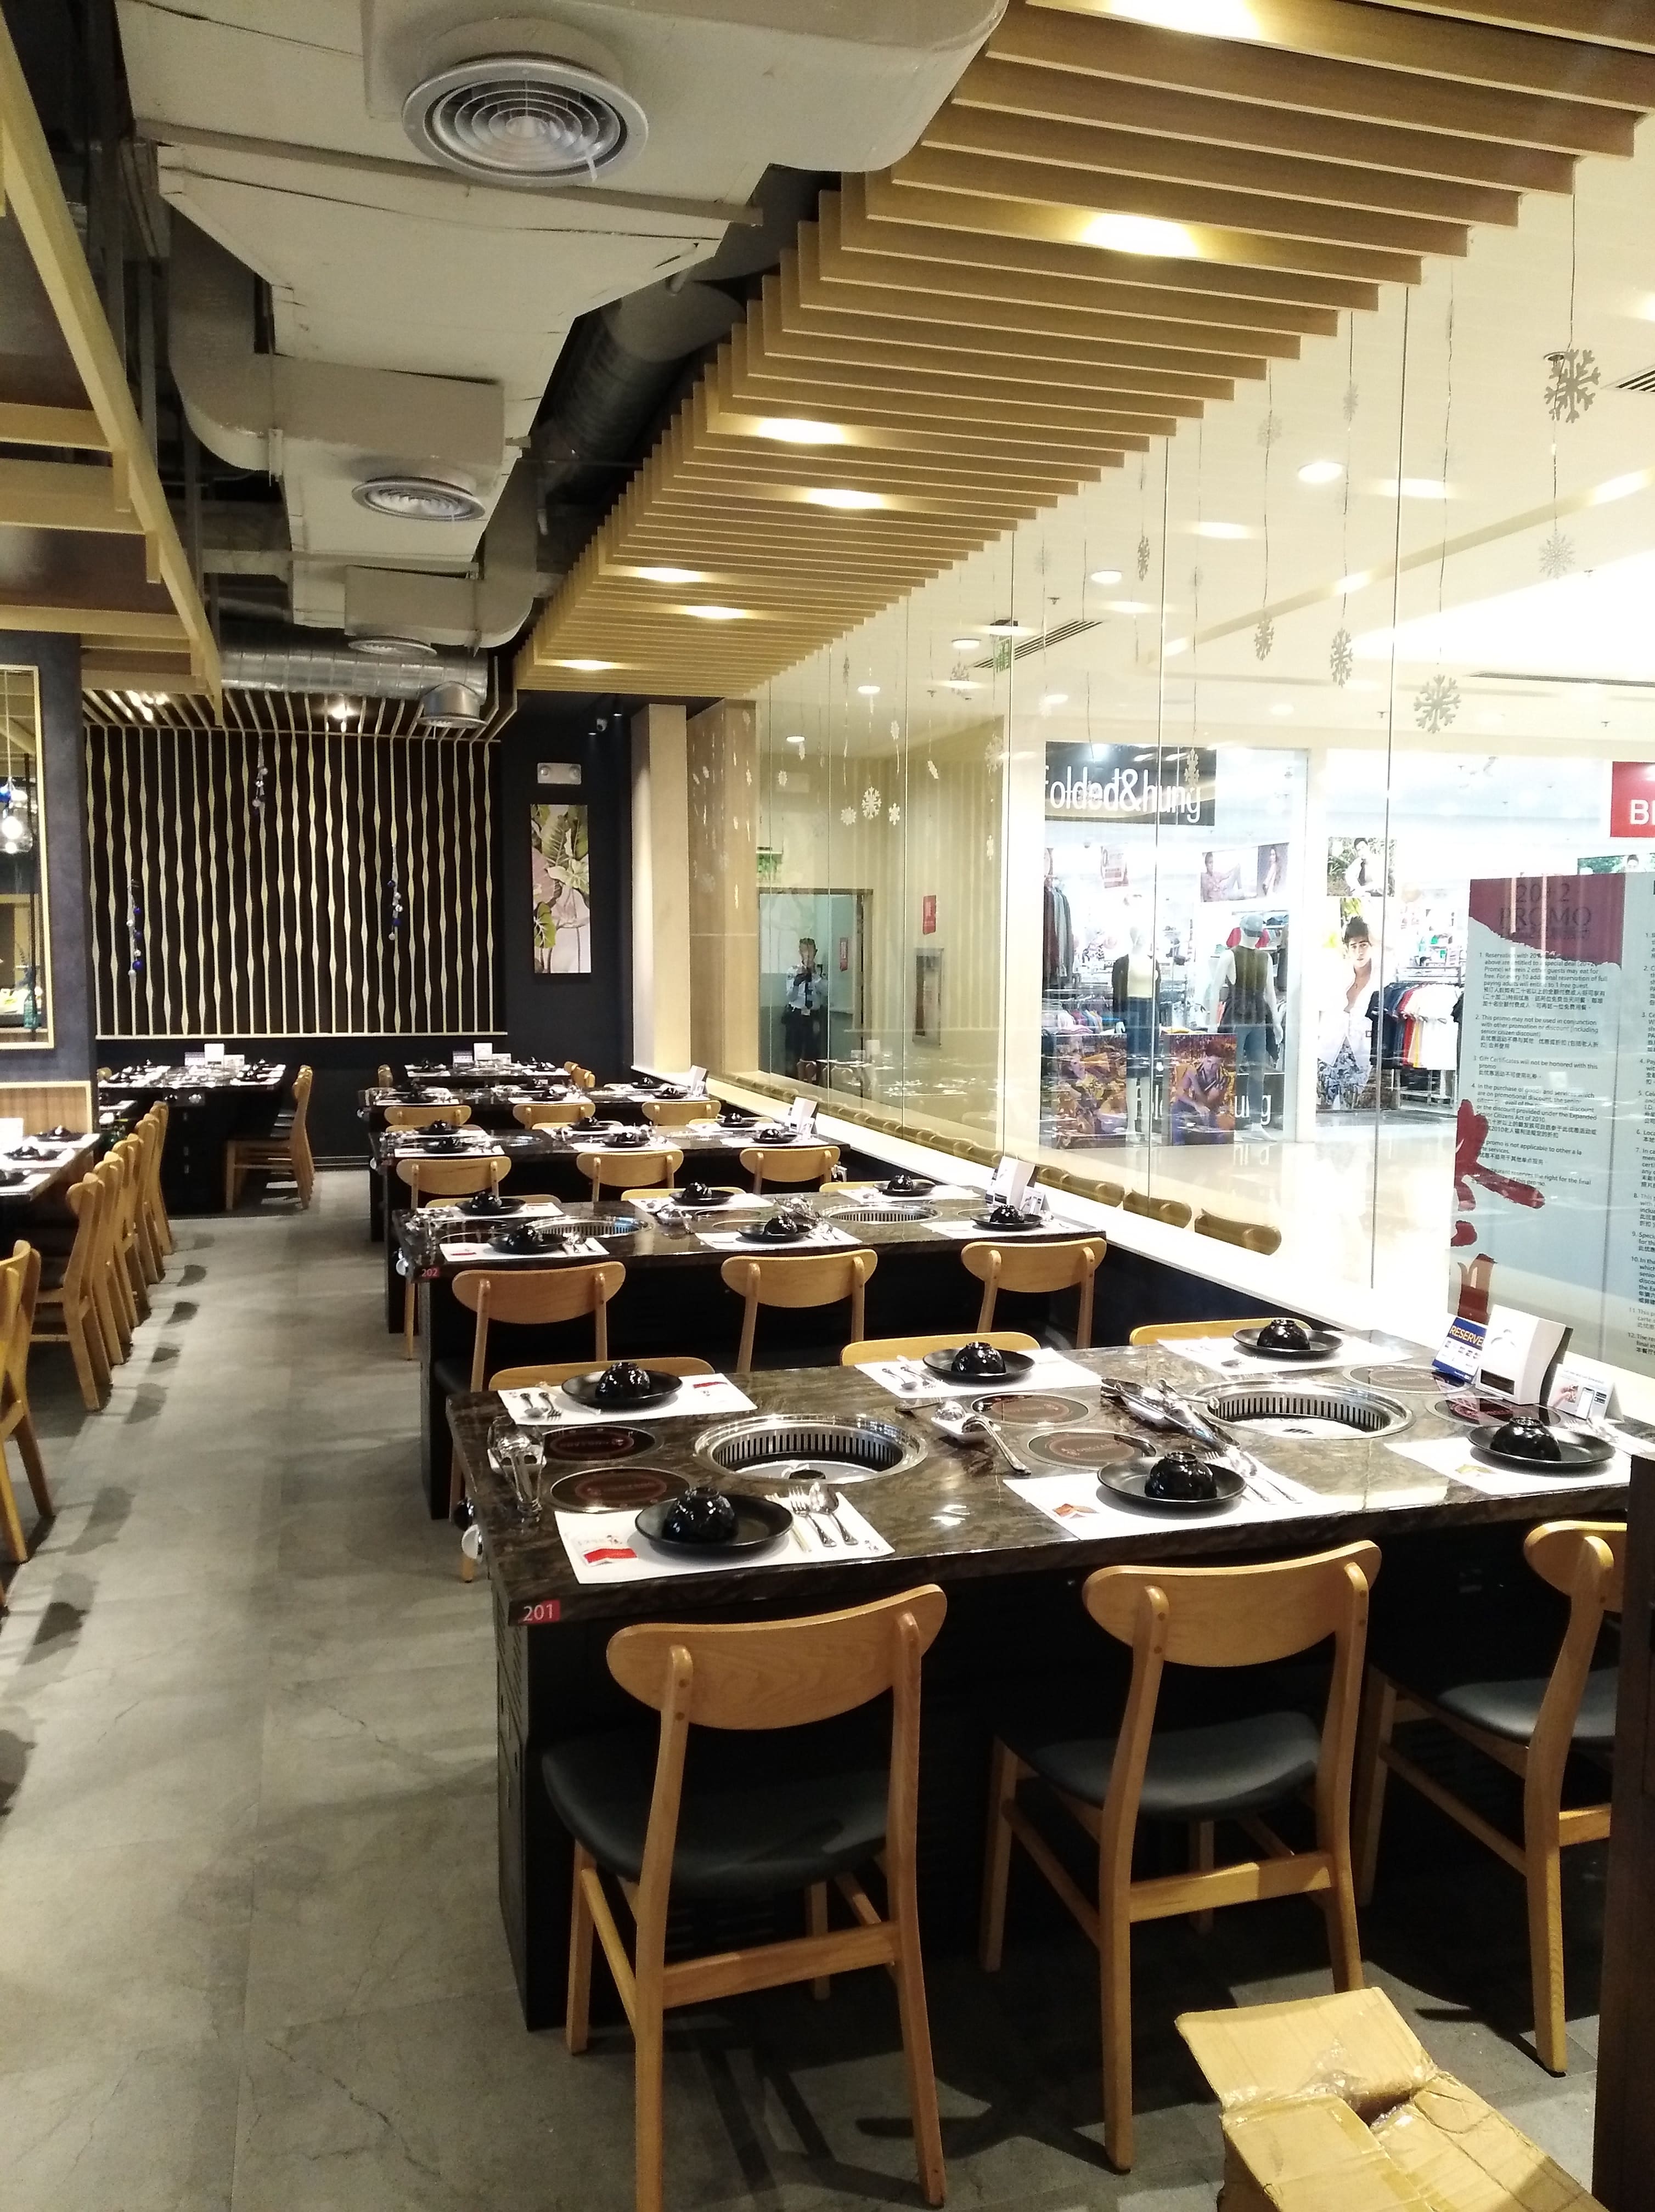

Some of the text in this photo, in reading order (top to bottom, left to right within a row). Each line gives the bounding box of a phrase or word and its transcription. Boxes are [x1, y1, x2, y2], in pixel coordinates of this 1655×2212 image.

[1630, 799, 1655, 825] B
[1500, 907, 1591, 927] PROMO
[421, 1268, 438, 1277] 202
[1449, 1325, 1485, 1346] RESERVE
[522, 1604, 553, 1622] 201
